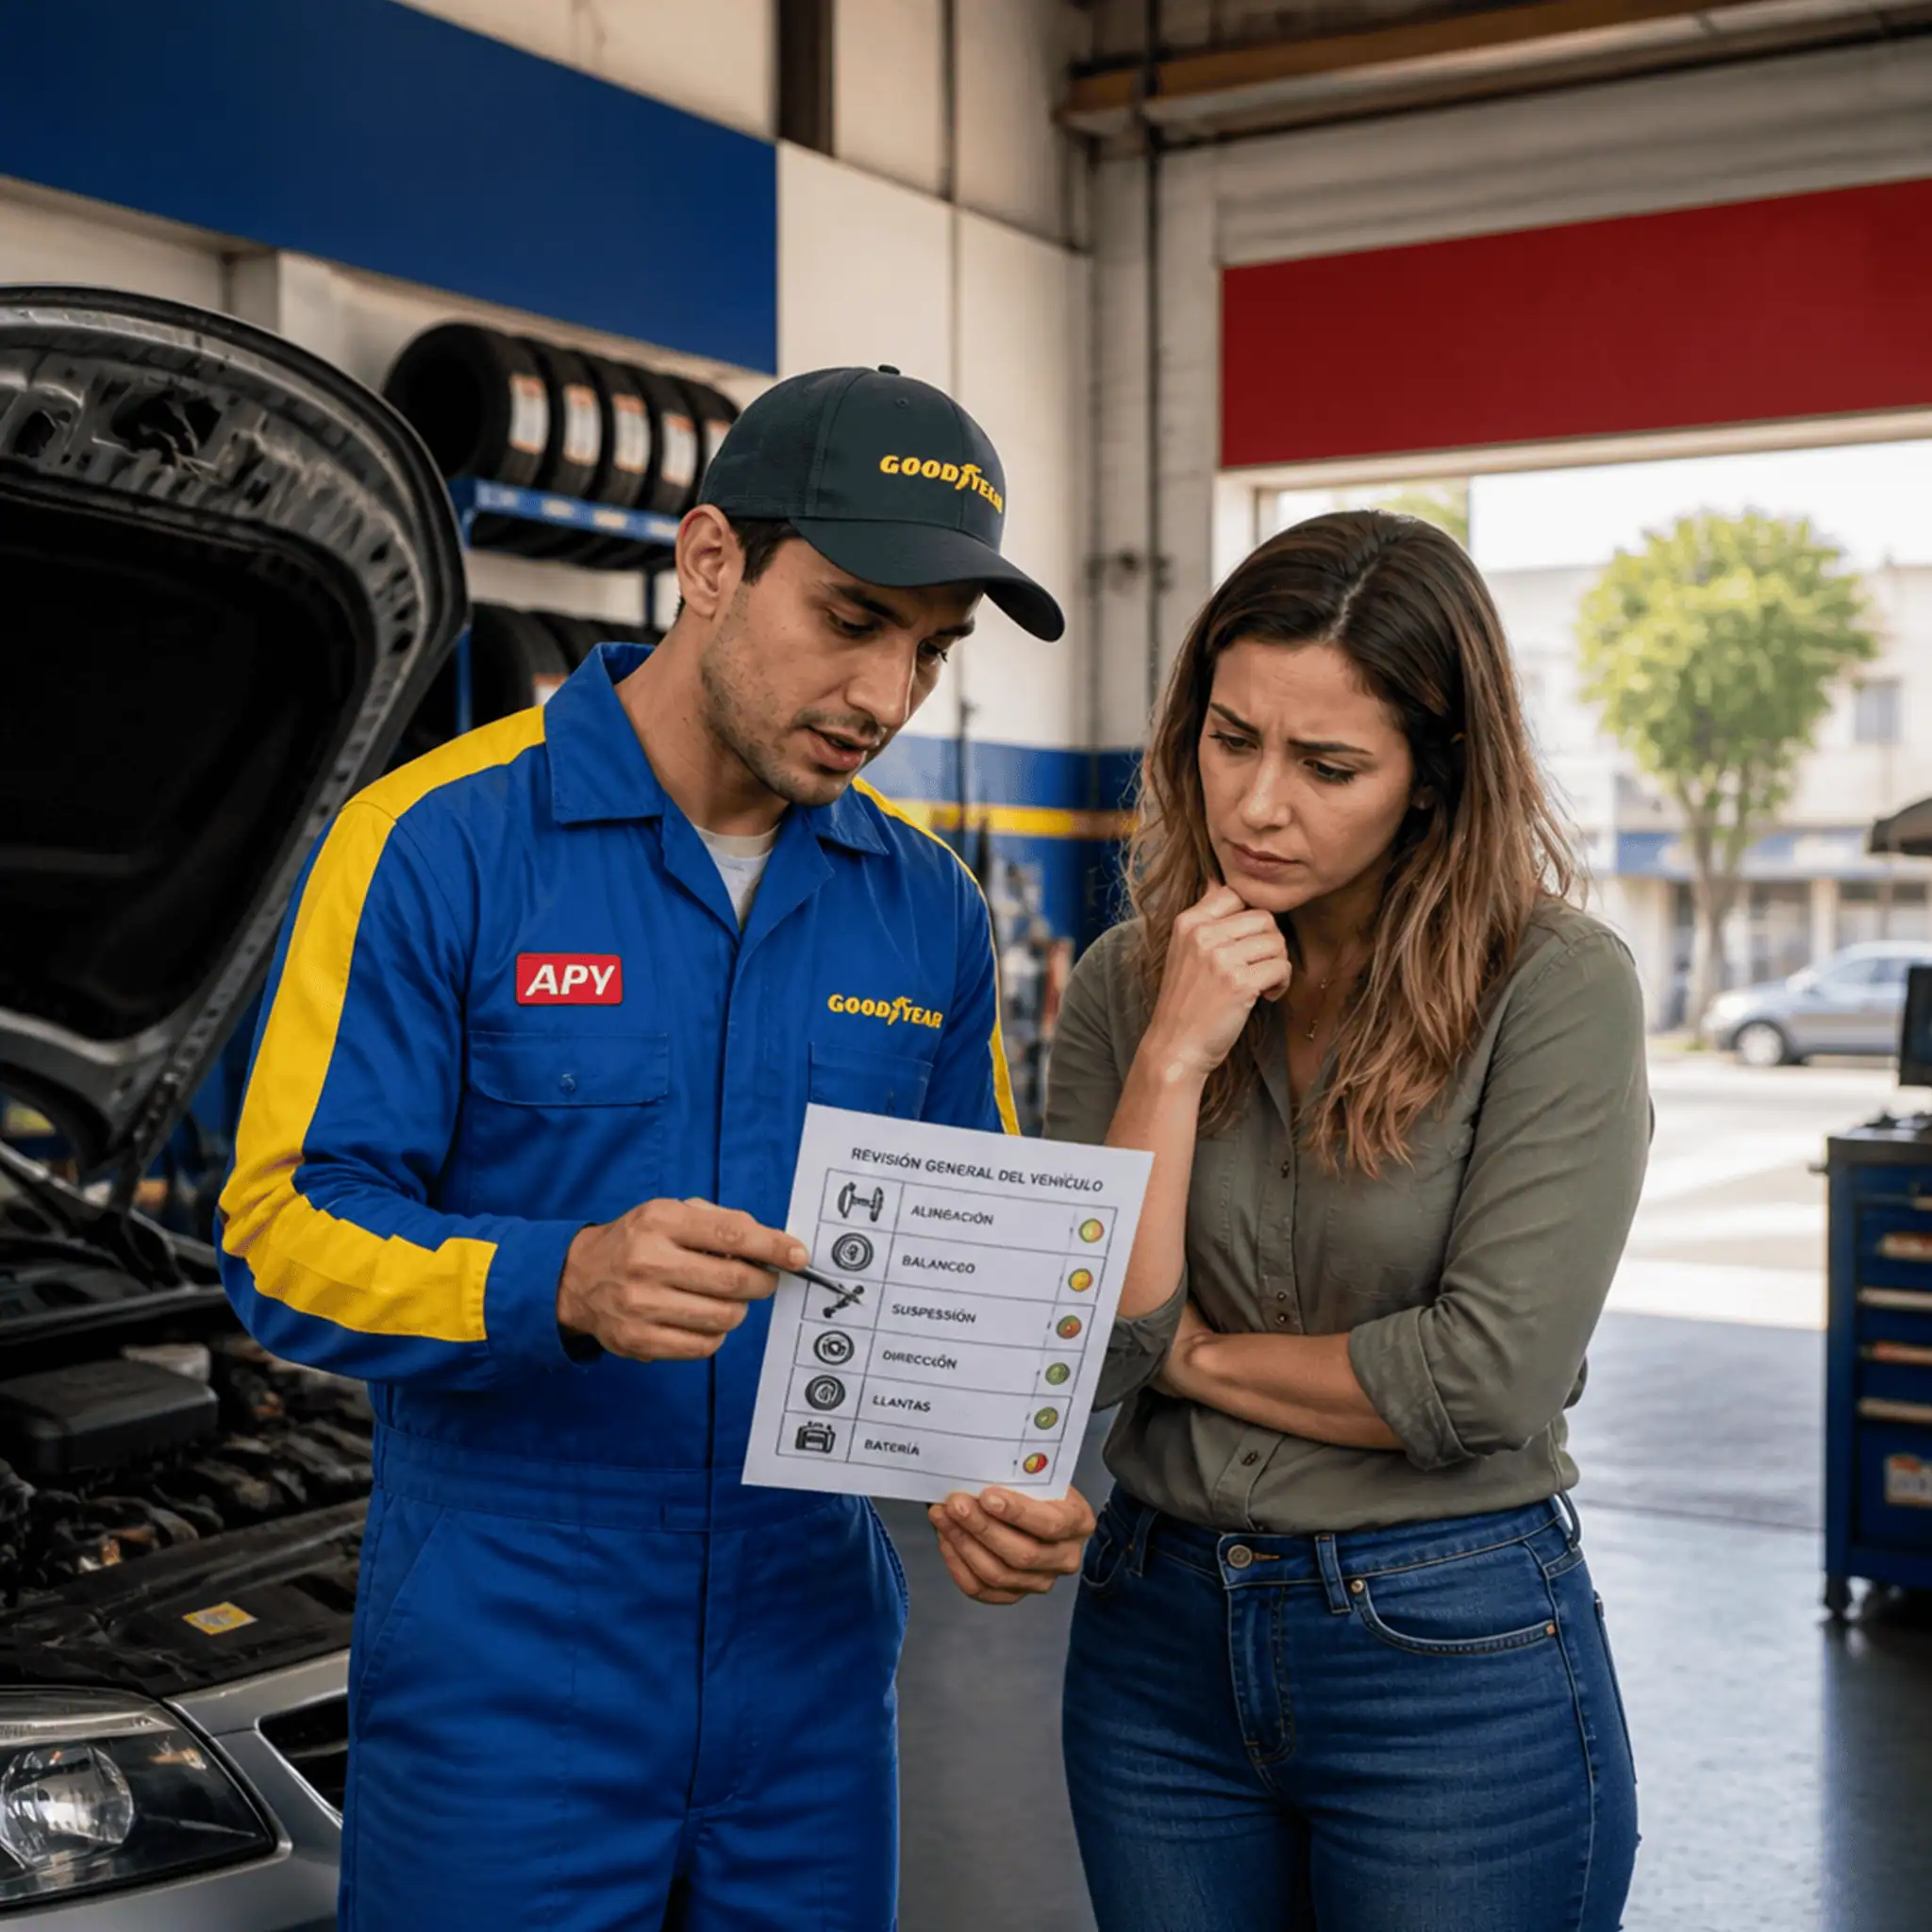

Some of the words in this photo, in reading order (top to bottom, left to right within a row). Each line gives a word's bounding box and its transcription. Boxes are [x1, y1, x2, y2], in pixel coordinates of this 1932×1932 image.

[525, 964, 615, 996] APY
[827, 993, 942, 1028] GOODYEAR
[851, 1147, 922, 1170] REVISIÓN
[925, 1159, 993, 1180] GENERAL
[998, 1170, 1025, 1184] DEL
[873, 1395, 930, 1412] LLANTAS
